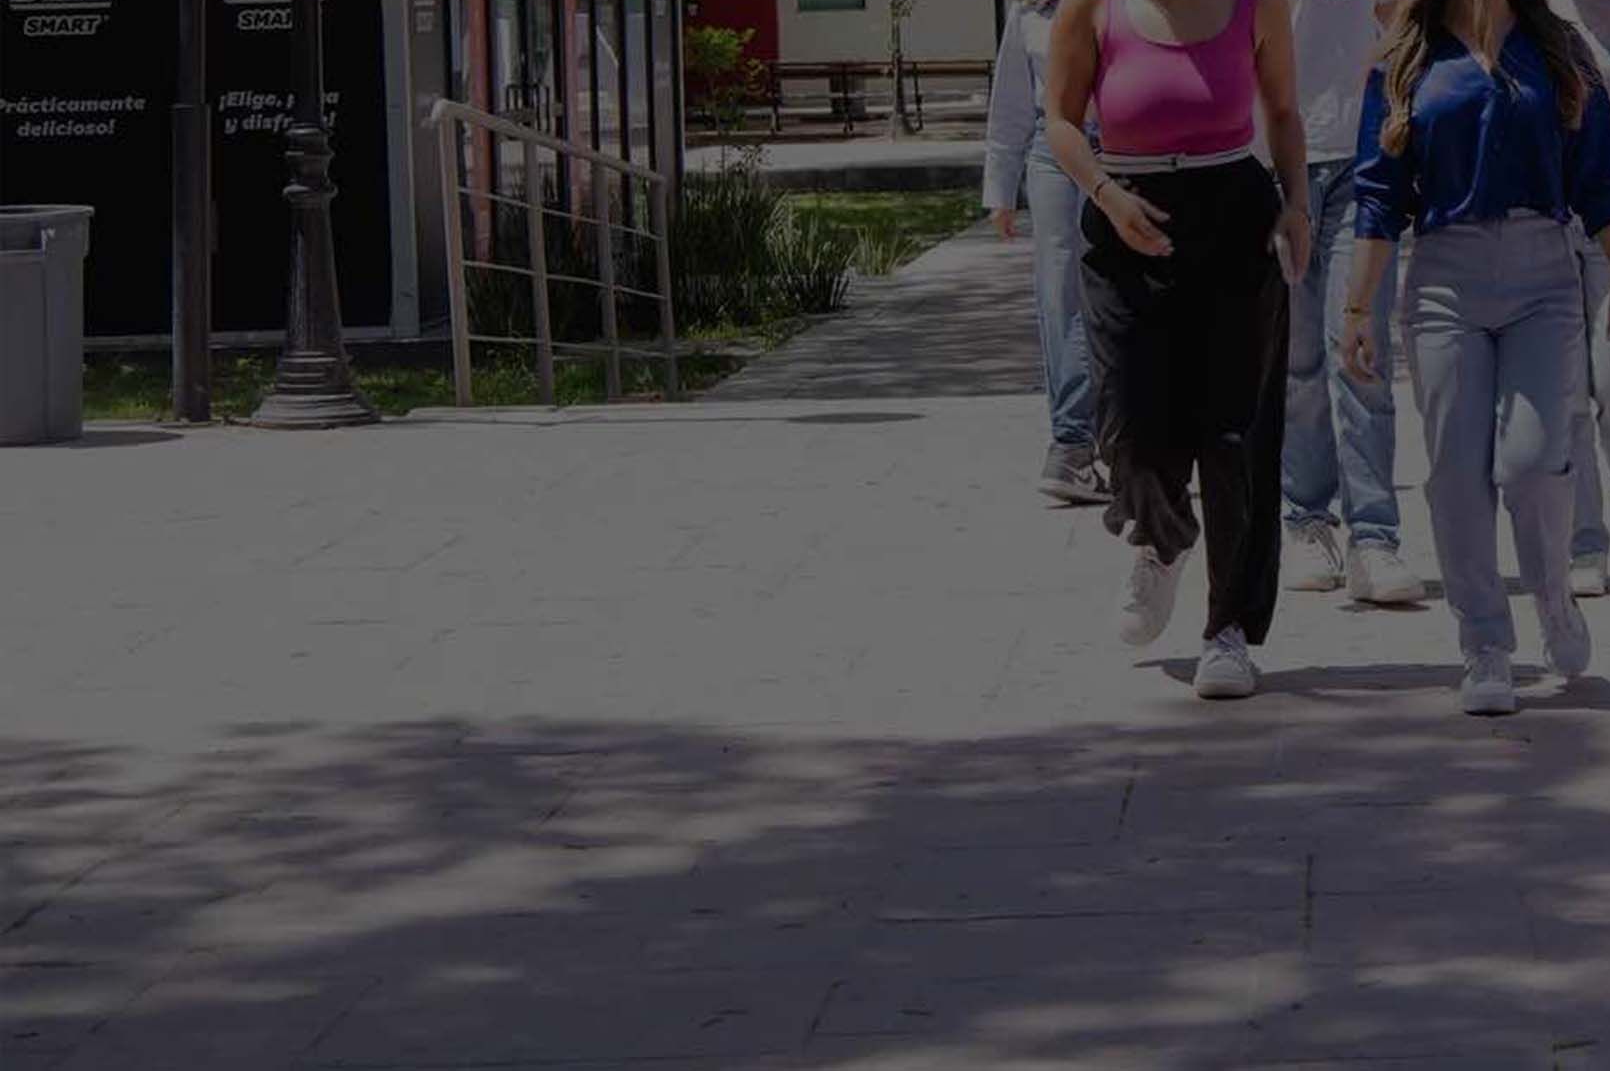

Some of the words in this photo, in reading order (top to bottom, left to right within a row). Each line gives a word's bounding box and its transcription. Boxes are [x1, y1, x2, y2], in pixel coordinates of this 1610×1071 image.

[26, 18, 99, 33] SMART
[240, 11, 292, 28] SMA
[16, 118, 117, 137] delicioso!
